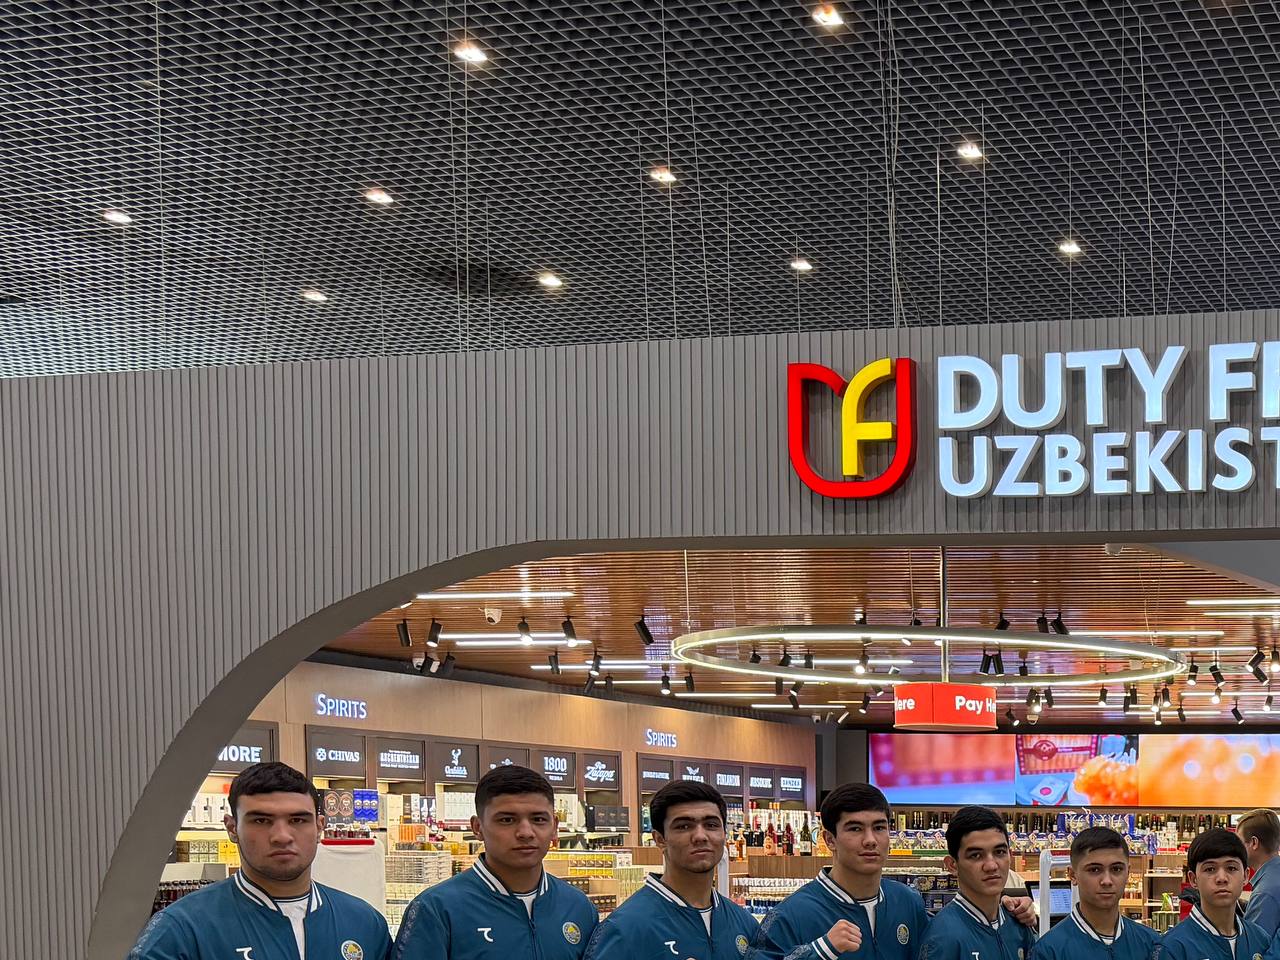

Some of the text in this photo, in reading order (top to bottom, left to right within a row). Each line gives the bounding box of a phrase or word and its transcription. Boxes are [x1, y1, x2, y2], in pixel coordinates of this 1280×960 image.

[938, 345, 1188, 431] DUTY
[317, 693, 367, 719] SPIRITS
[894, 695, 996, 715] ere Pay He
[646, 728, 677, 748] SPIRITS
[329, 750, 360, 762] CHIVAS
[544, 756, 568, 772] 1800
